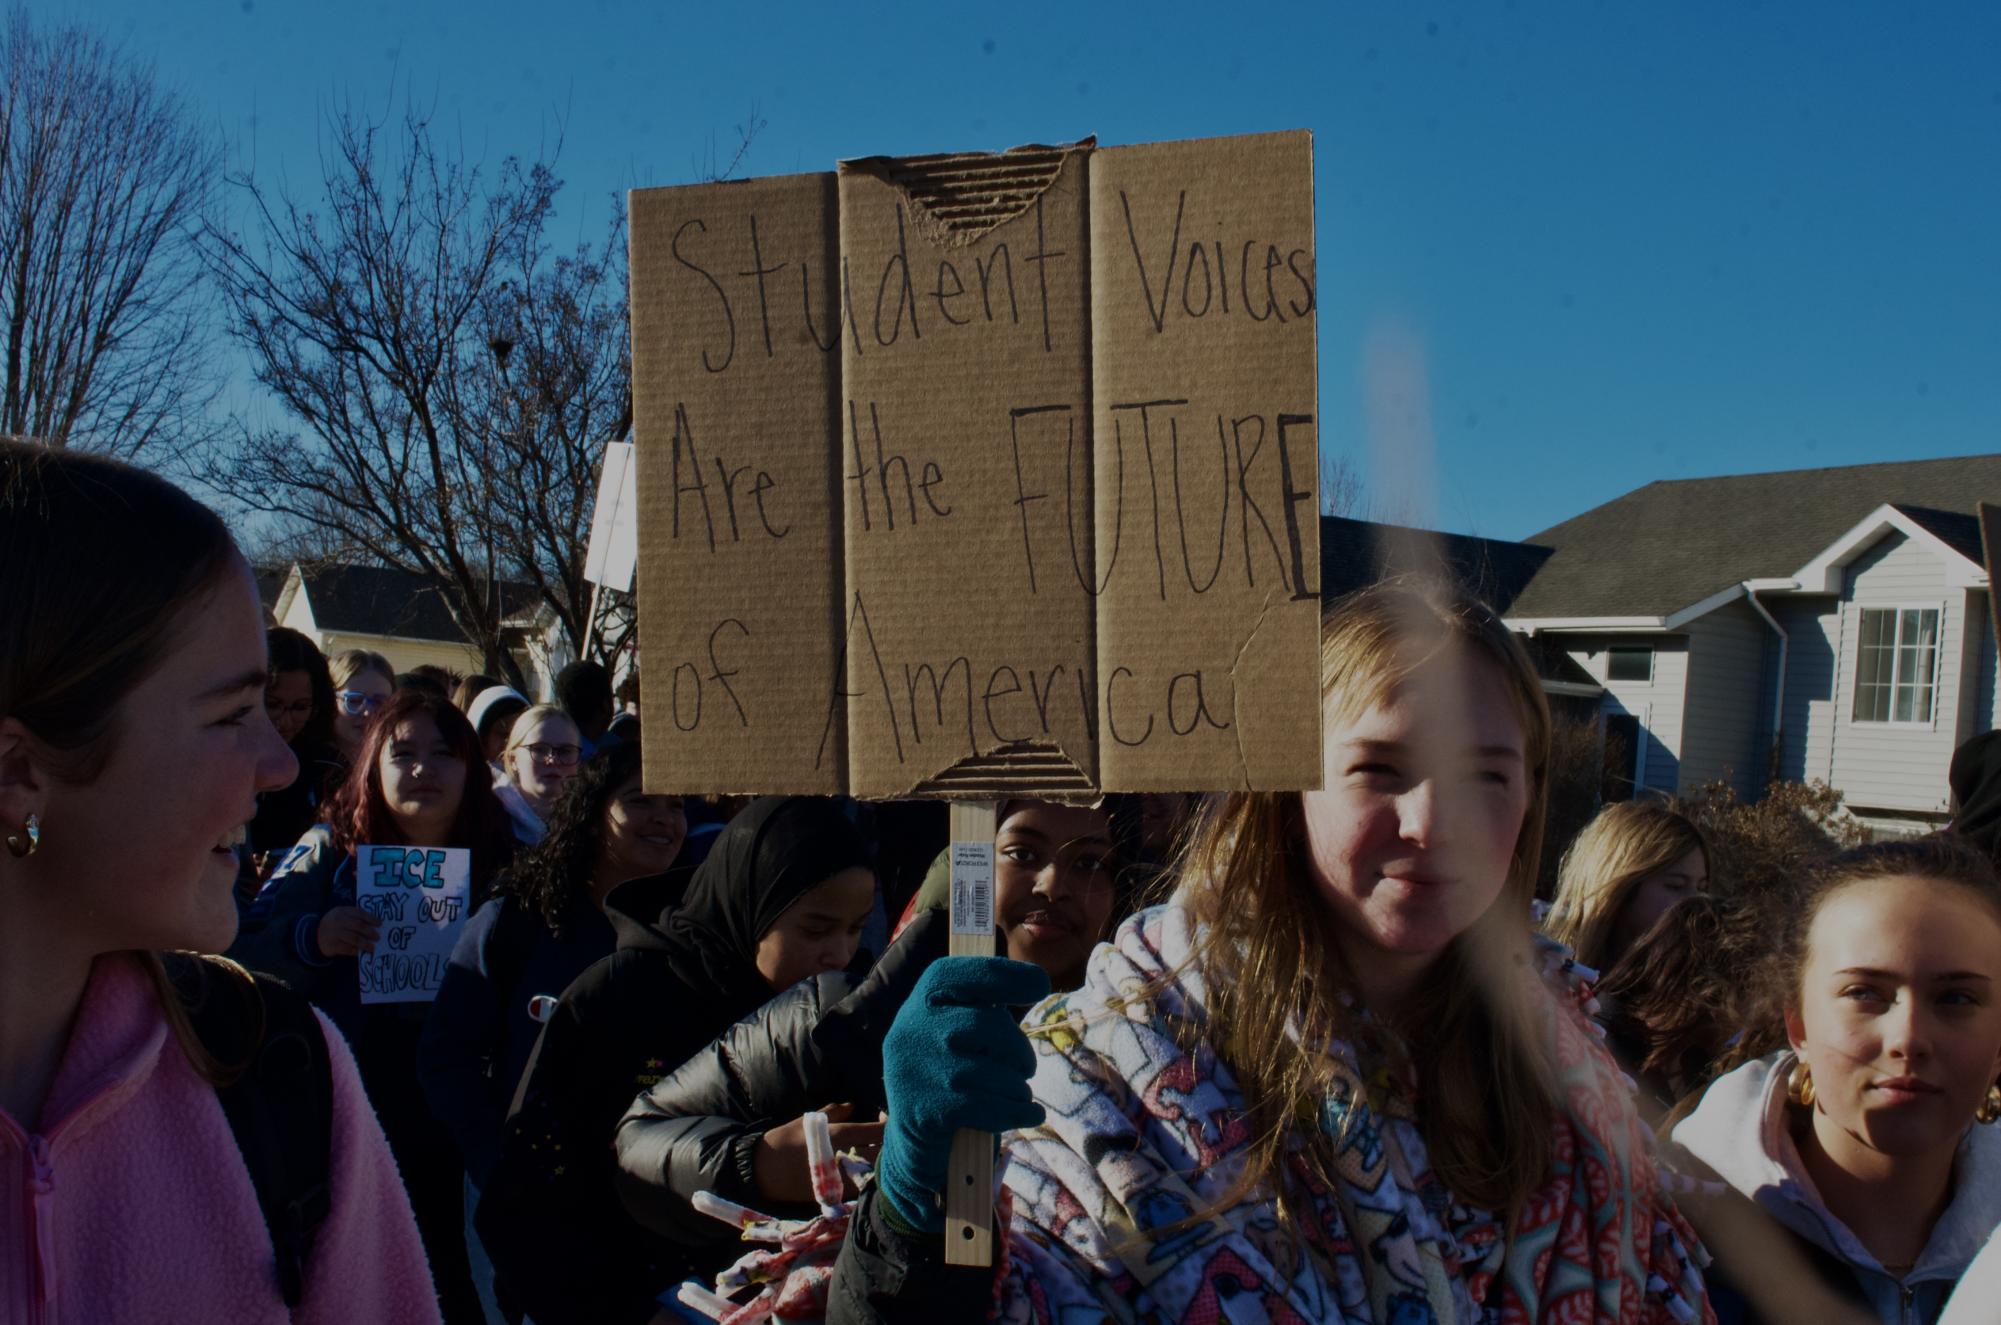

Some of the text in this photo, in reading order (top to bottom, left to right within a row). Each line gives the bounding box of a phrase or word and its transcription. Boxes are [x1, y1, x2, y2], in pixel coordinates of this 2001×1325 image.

[671, 190, 1315, 373] Student Voices
[672, 398, 1320, 601] Are the FUTURE
[672, 588, 1231, 771] of America
[370, 847, 446, 889] ICE
[358, 892, 463, 923] STAY OUT
[387, 926, 416, 950] OF
[360, 951, 451, 994] SCHOOL
